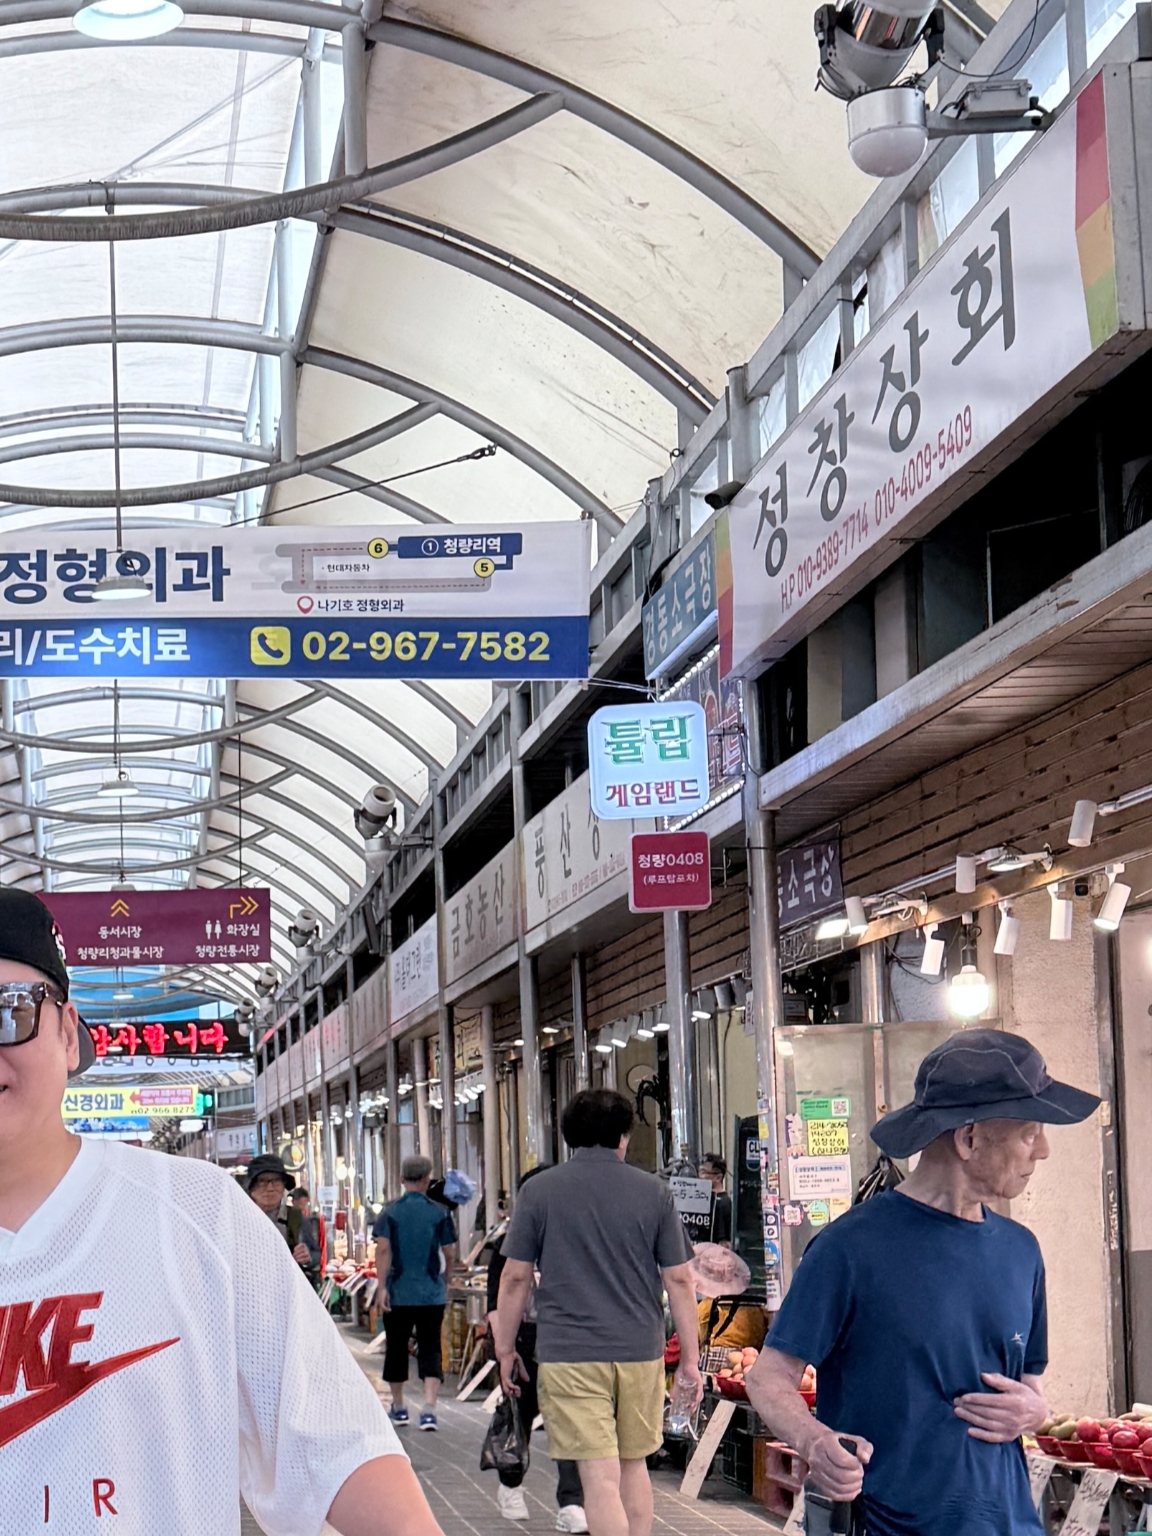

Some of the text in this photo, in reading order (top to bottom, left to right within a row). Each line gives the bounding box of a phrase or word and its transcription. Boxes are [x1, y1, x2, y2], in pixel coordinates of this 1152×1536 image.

[752, 206, 1017, 579] 성창상회
[798, 502, 868, 598] 010-9389-7714
[875, 404, 972, 527] 010-4009-5409
[443, 536, 501, 555] 청량리역
[318, 599, 404, 613] 나기호 정형외과
[302, 630, 550, 662] 02-967-7582
[603, 714, 695, 764] 튤립
[606, 778, 700, 808] 게임랜드
[638, 852, 704, 869] 청량0408
[643, 873, 699, 885] (루프탑포차)
[451, 862, 505, 960] 금호농산
[98, 926, 142, 939] 동서시장
[226, 924, 260, 937] 화장실
[77, 946, 164, 960] 청량리청과물시장
[196, 945, 260, 958] 청량전통시장
[64, 1092, 125, 1112] 신경외과
[680, 1213, 710, 1226] 0408
